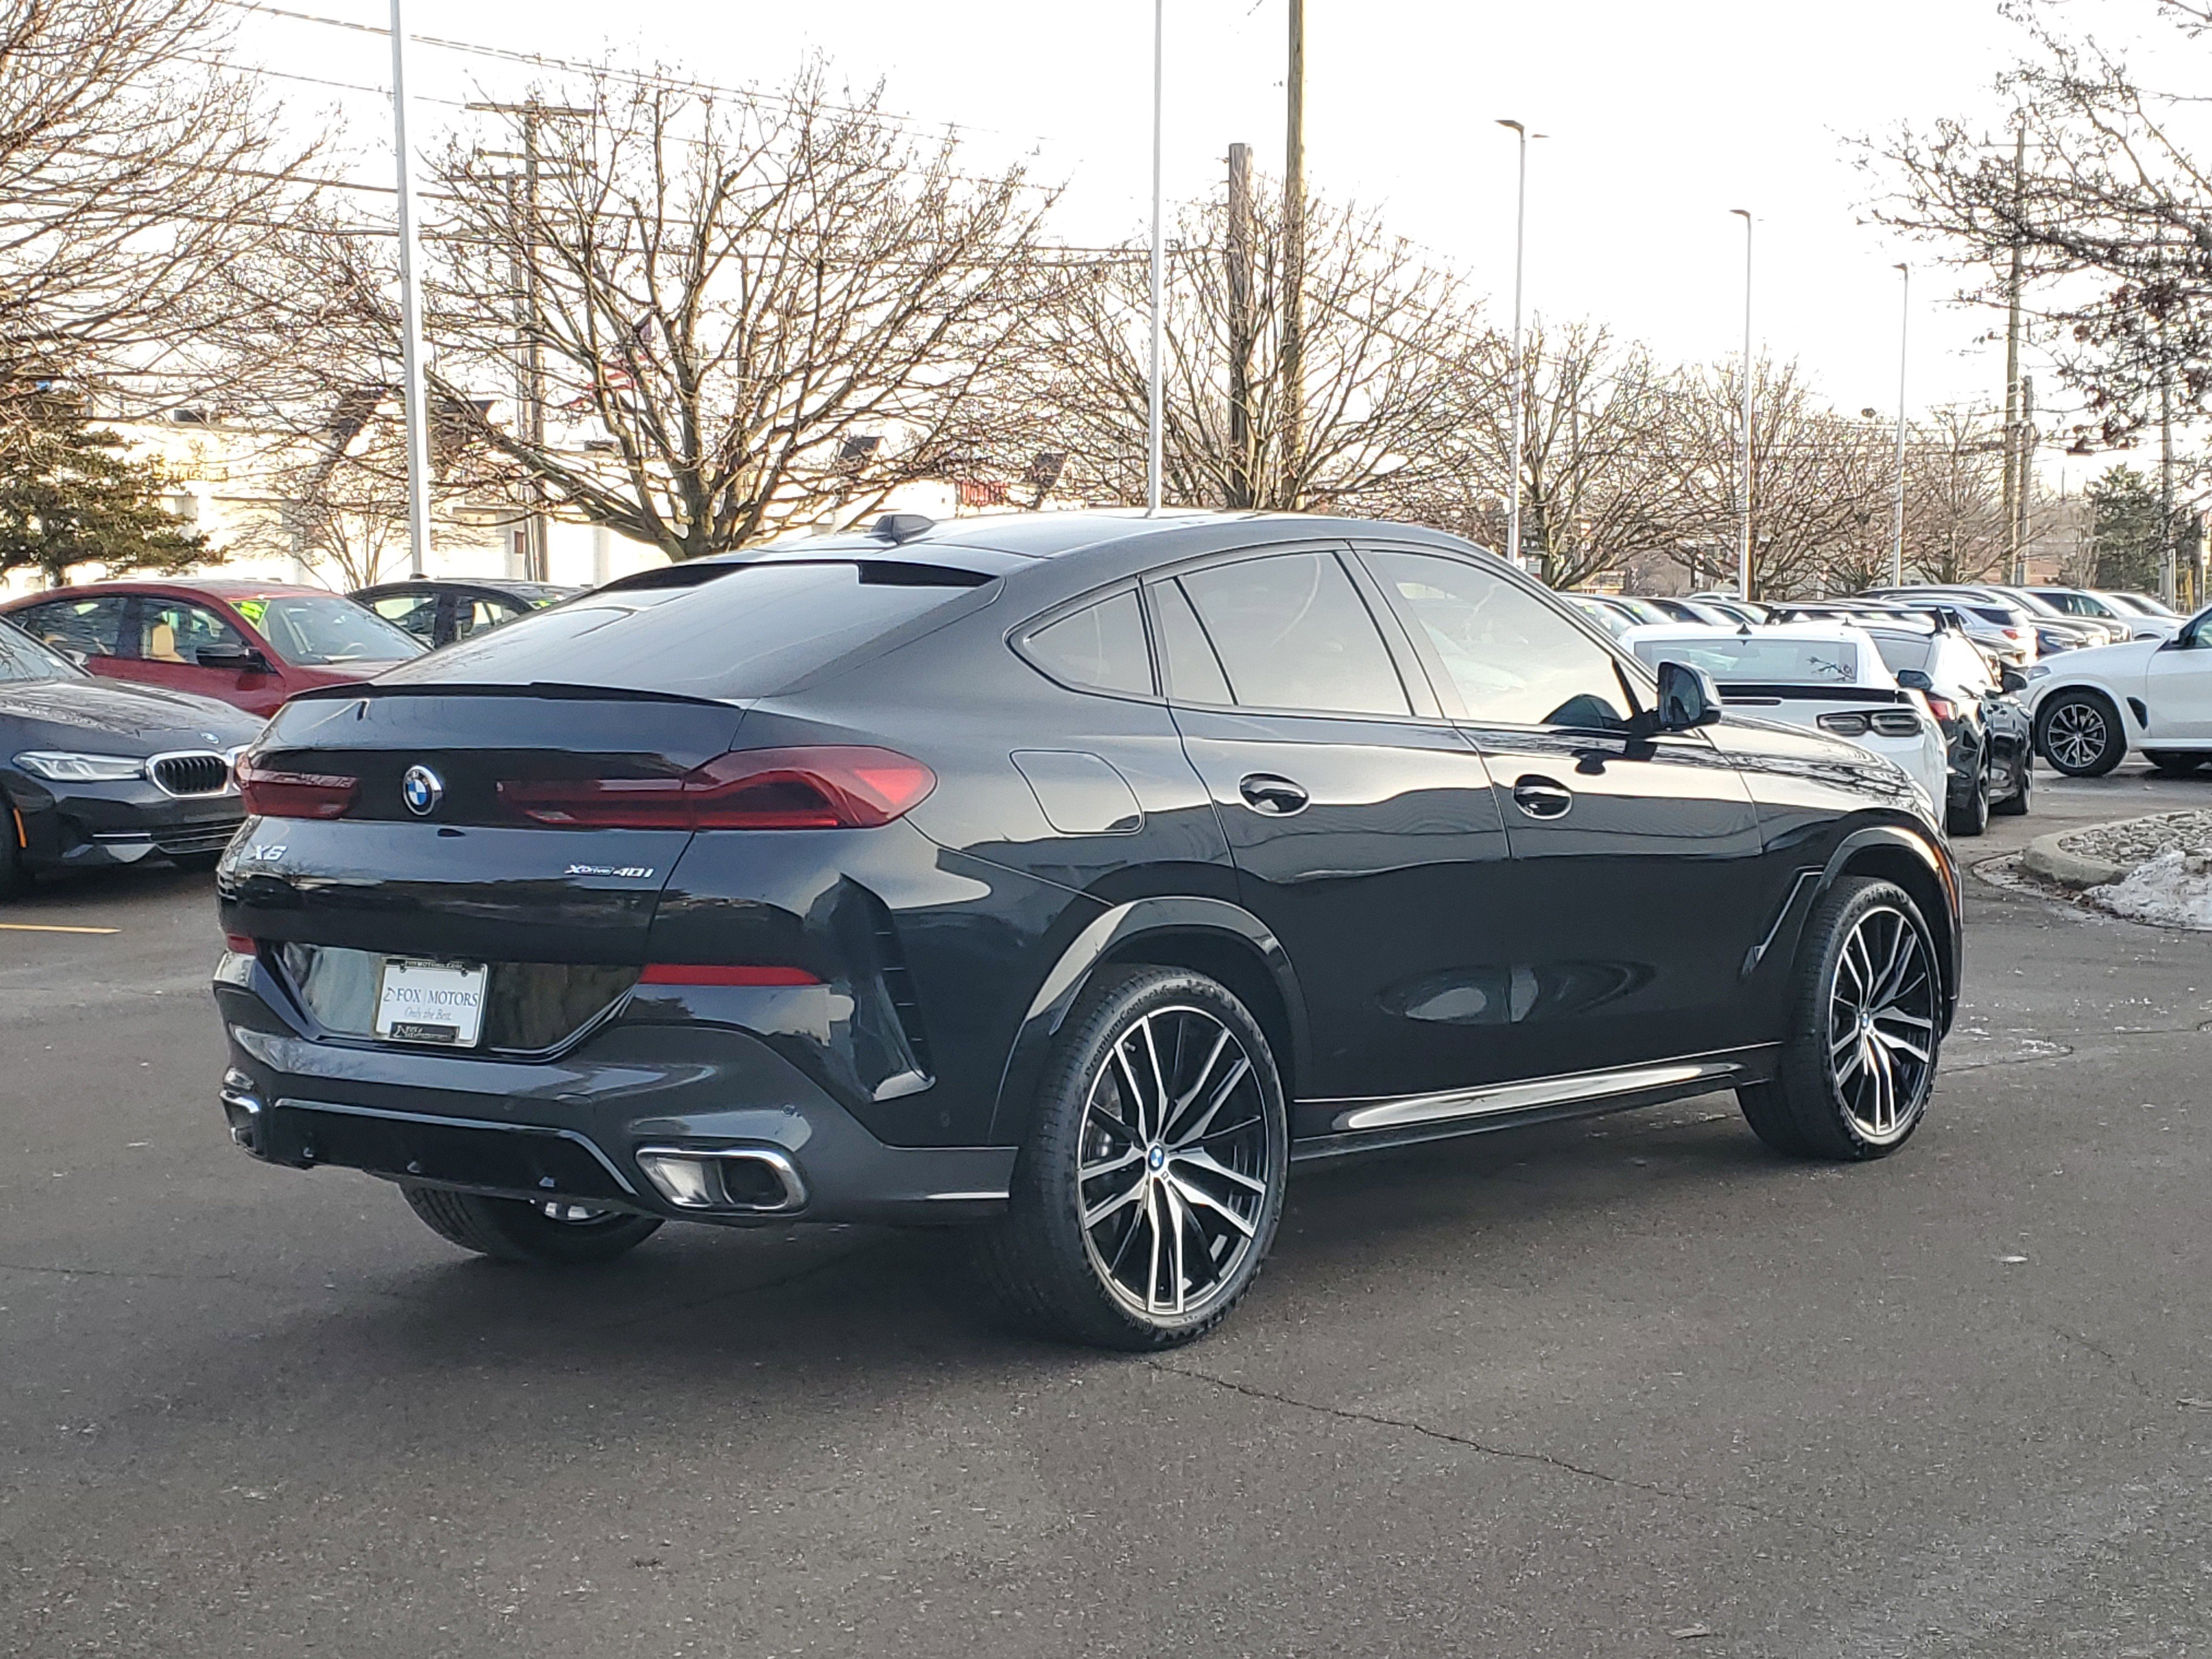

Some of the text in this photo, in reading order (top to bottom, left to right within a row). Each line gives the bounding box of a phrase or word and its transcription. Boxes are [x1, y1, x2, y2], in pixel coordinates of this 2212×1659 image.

[245, 845, 287, 861] X6
[396, 988, 478, 1007] FOX MOTORS
